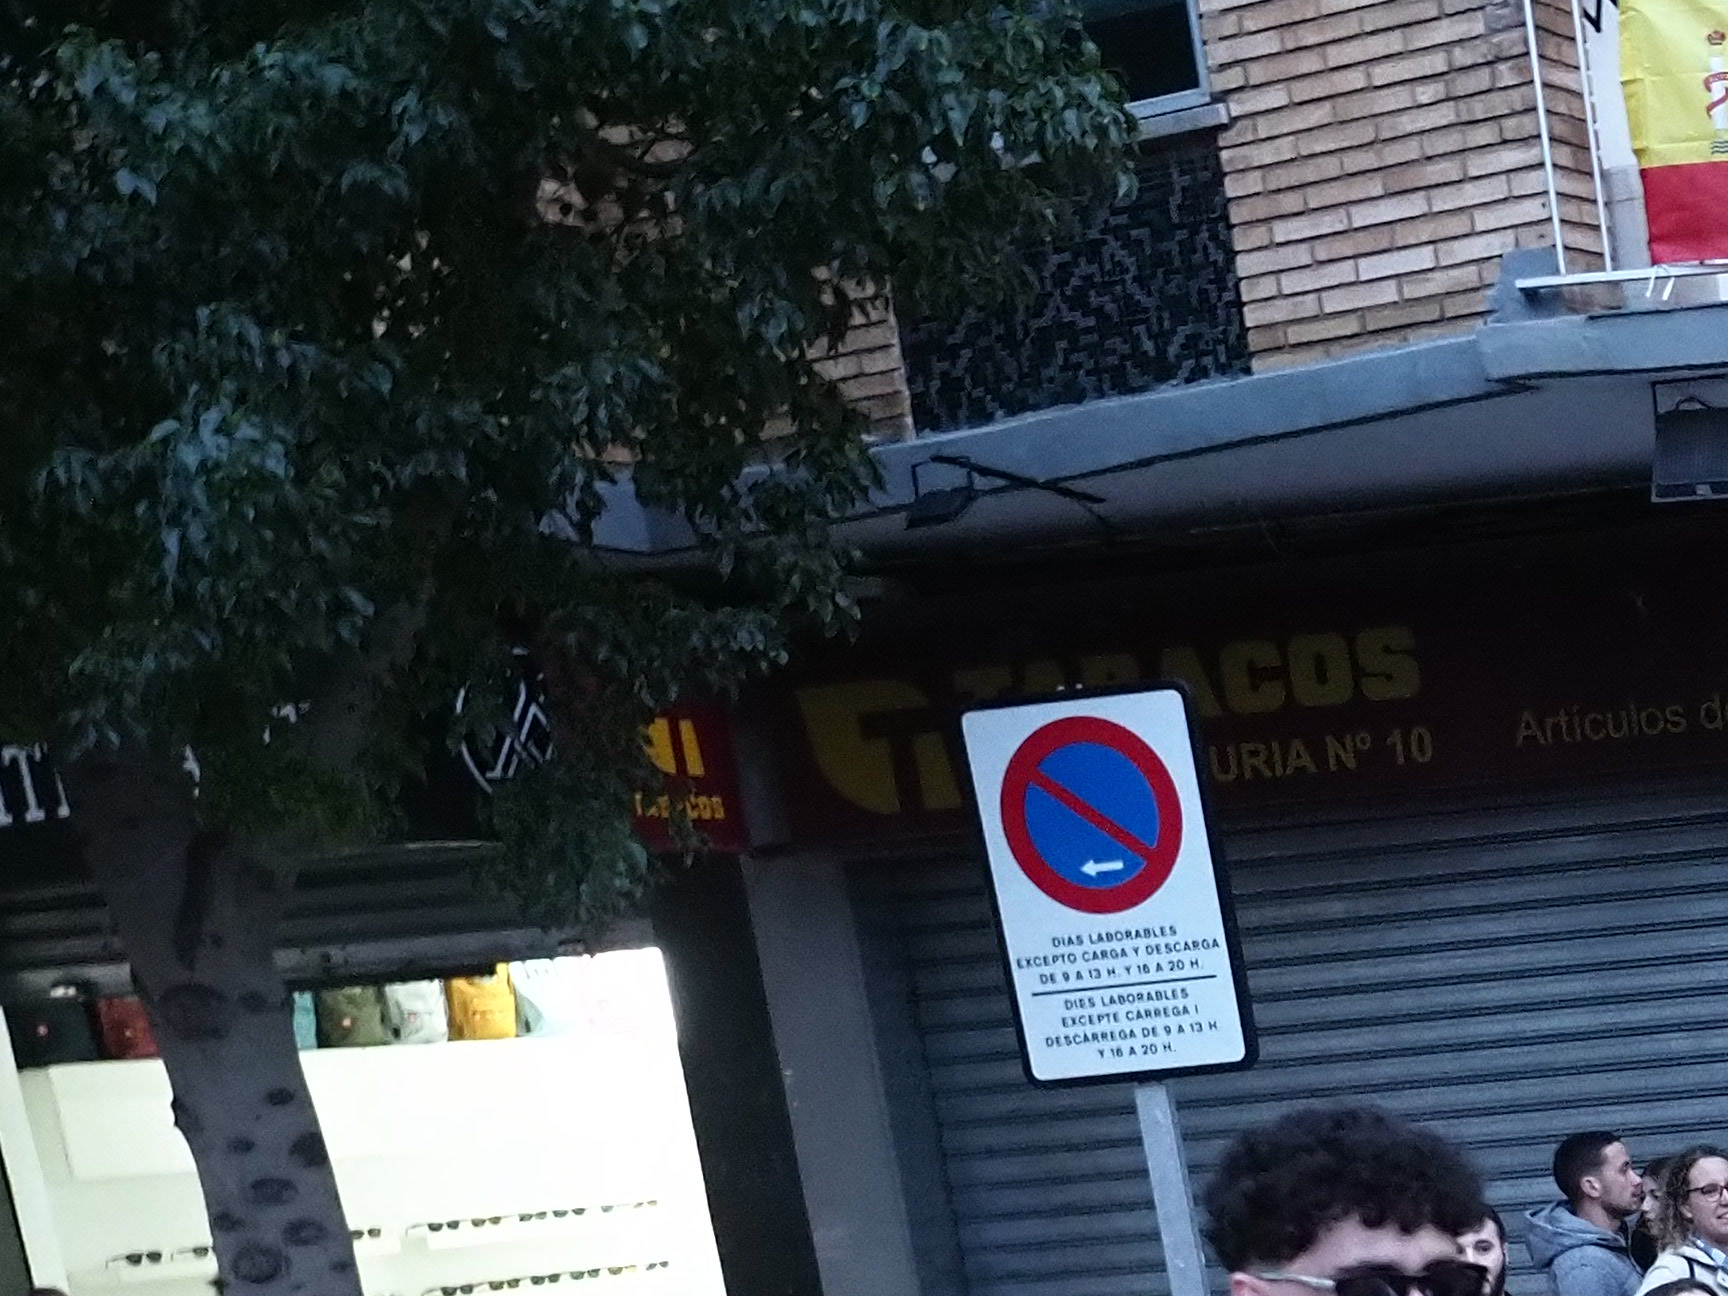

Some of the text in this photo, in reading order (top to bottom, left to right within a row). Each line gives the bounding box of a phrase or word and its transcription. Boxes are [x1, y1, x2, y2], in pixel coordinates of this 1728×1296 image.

[1387, 728, 1434, 766] 10
[1089, 925, 1177, 945] LABORABLES
[1016, 938, 1220, 969] EXCEPTO CARGA Y DESCARGA
[1039, 972, 1057, 985] DE
[1075, 969, 1084, 980] A
[1089, 968, 1101, 979] 13
[1155, 962, 1164, 973] A
[1168, 960, 1185, 972] 20
[1064, 988, 1189, 1011] DIES LABORABLES
[1061, 1012, 1120, 1028] EXCEPTE
[1141, 1026, 1159, 1038] DE
[1177, 1023, 1186, 1034] A
[1191, 1022, 1204, 1033] 13
[1128, 1046, 1137, 1056] A
[1141, 1043, 1158, 1055] 20
